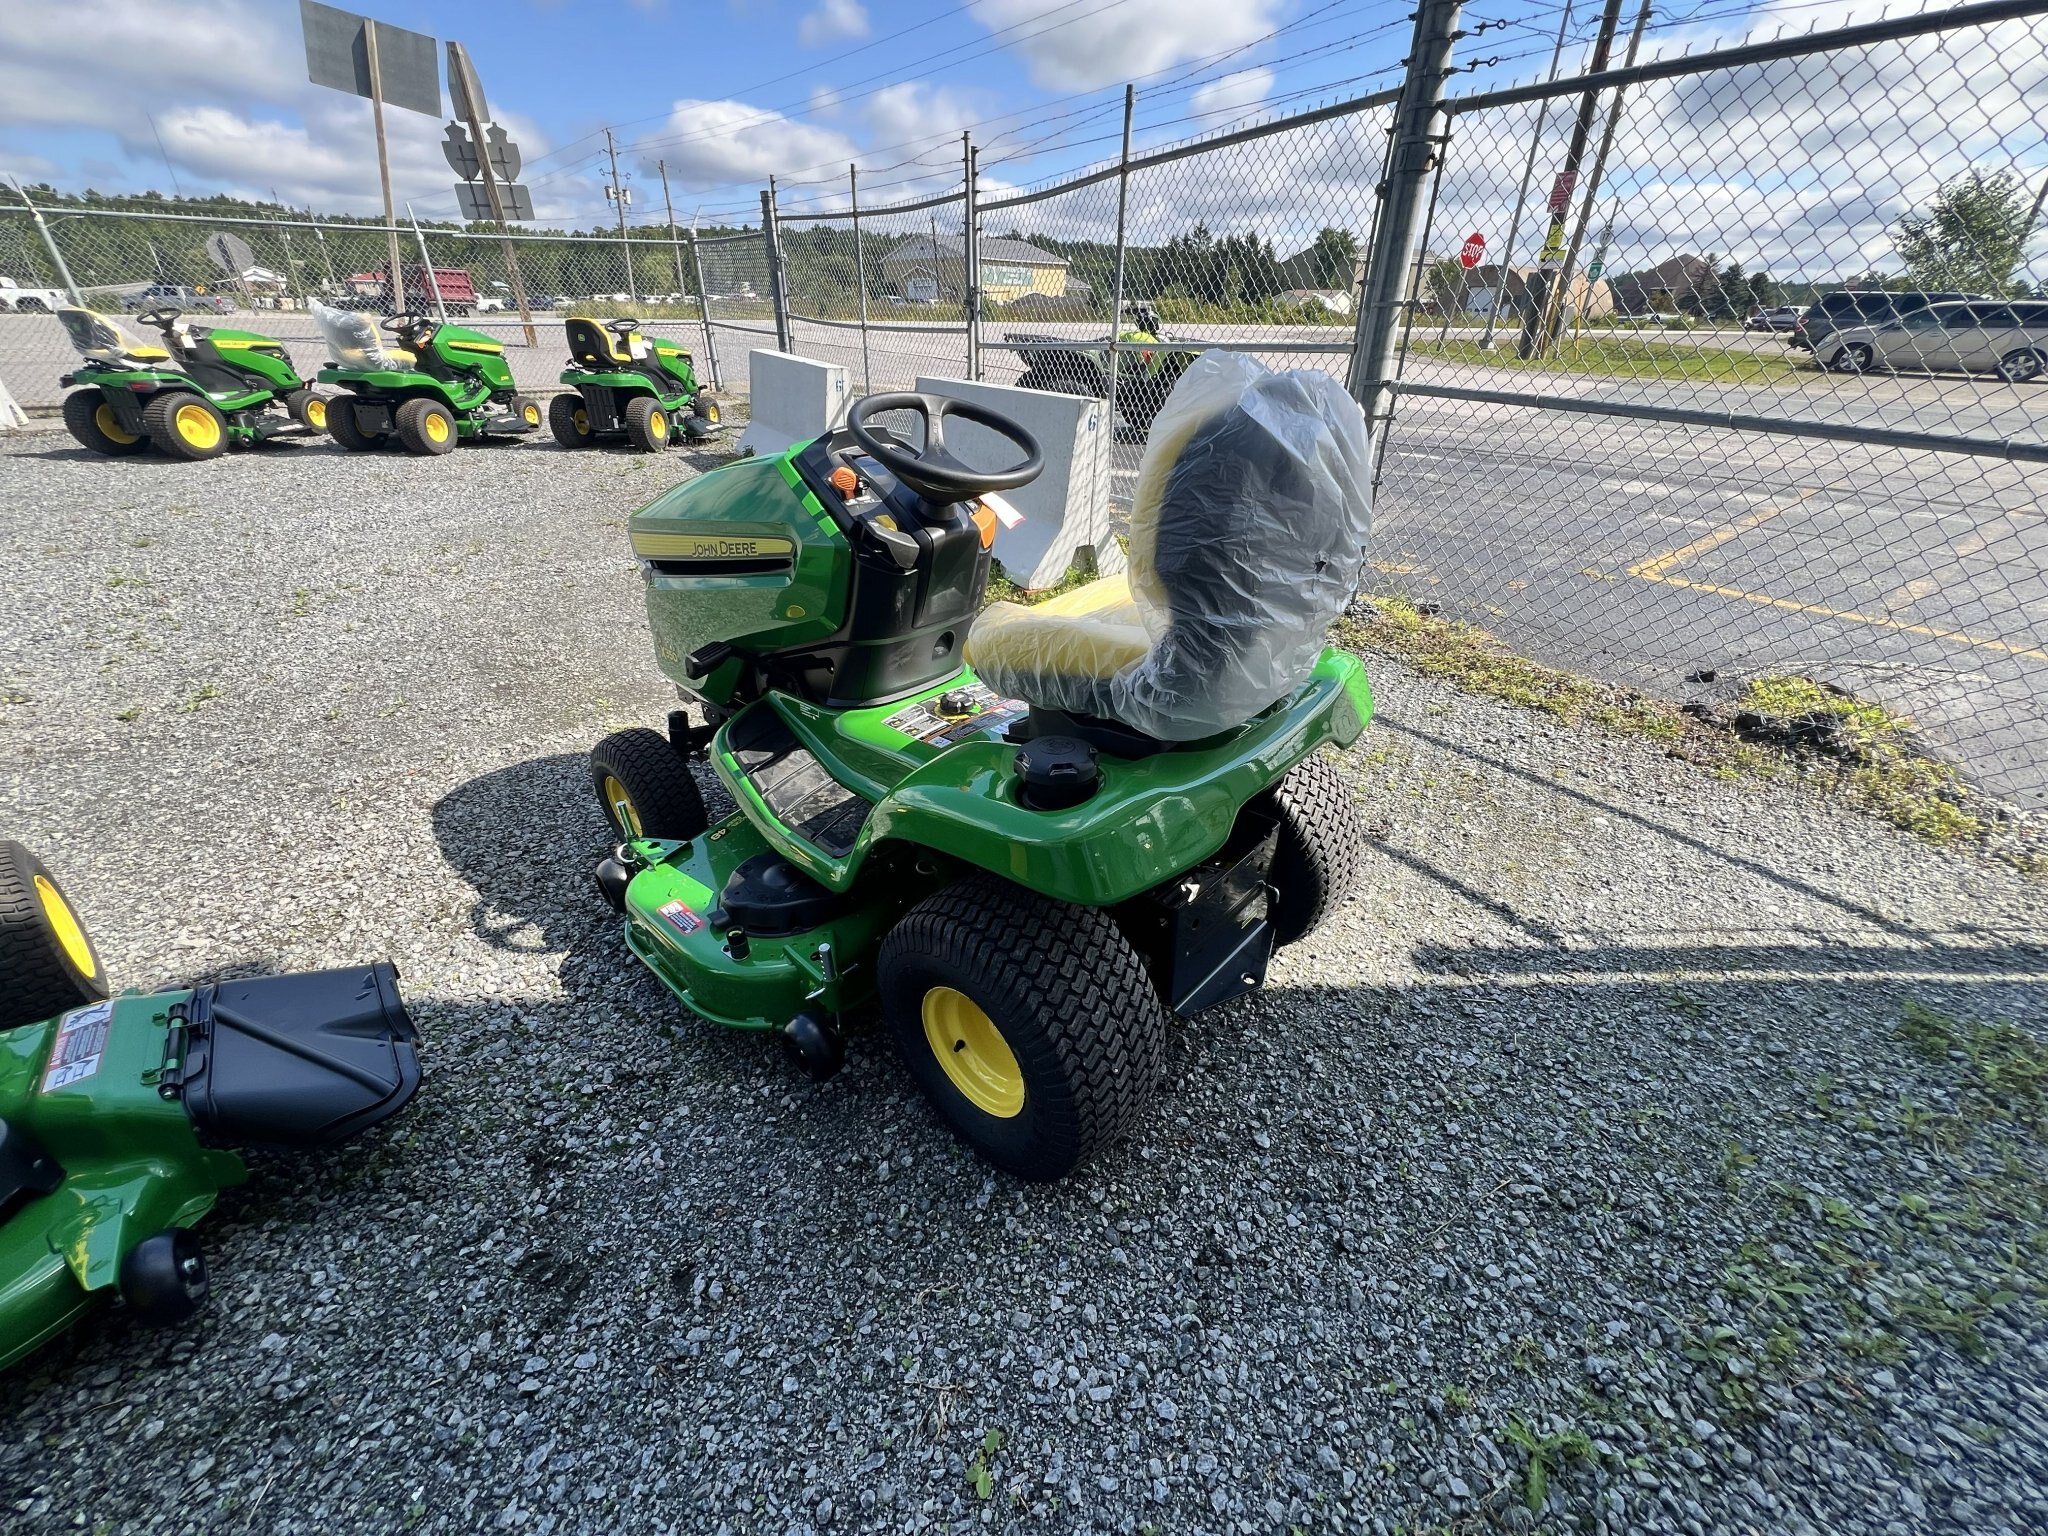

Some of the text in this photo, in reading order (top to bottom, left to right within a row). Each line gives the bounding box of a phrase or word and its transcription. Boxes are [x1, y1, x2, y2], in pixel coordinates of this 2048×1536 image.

[1463, 242, 1484, 259] STOP
[692, 541, 757, 556] JOHN DEERE
